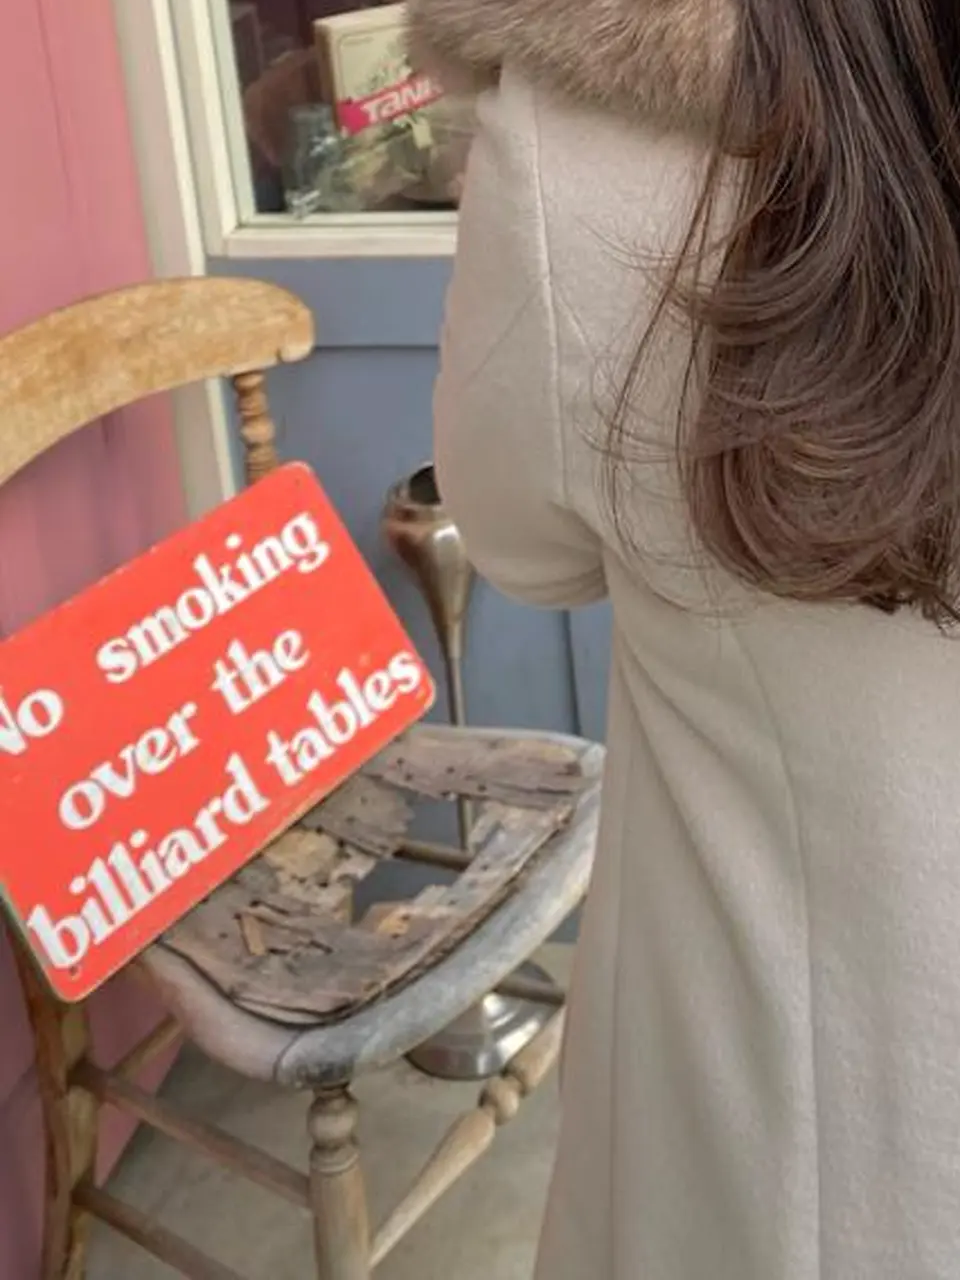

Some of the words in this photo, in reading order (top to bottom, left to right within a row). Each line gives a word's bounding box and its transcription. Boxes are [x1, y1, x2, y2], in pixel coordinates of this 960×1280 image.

[96, 509, 330, 684] smoking
[27, 751, 271, 971] billiard
[264, 647, 422, 787] tables
[59, 700, 201, 831] over
[210, 627, 310, 716] the
